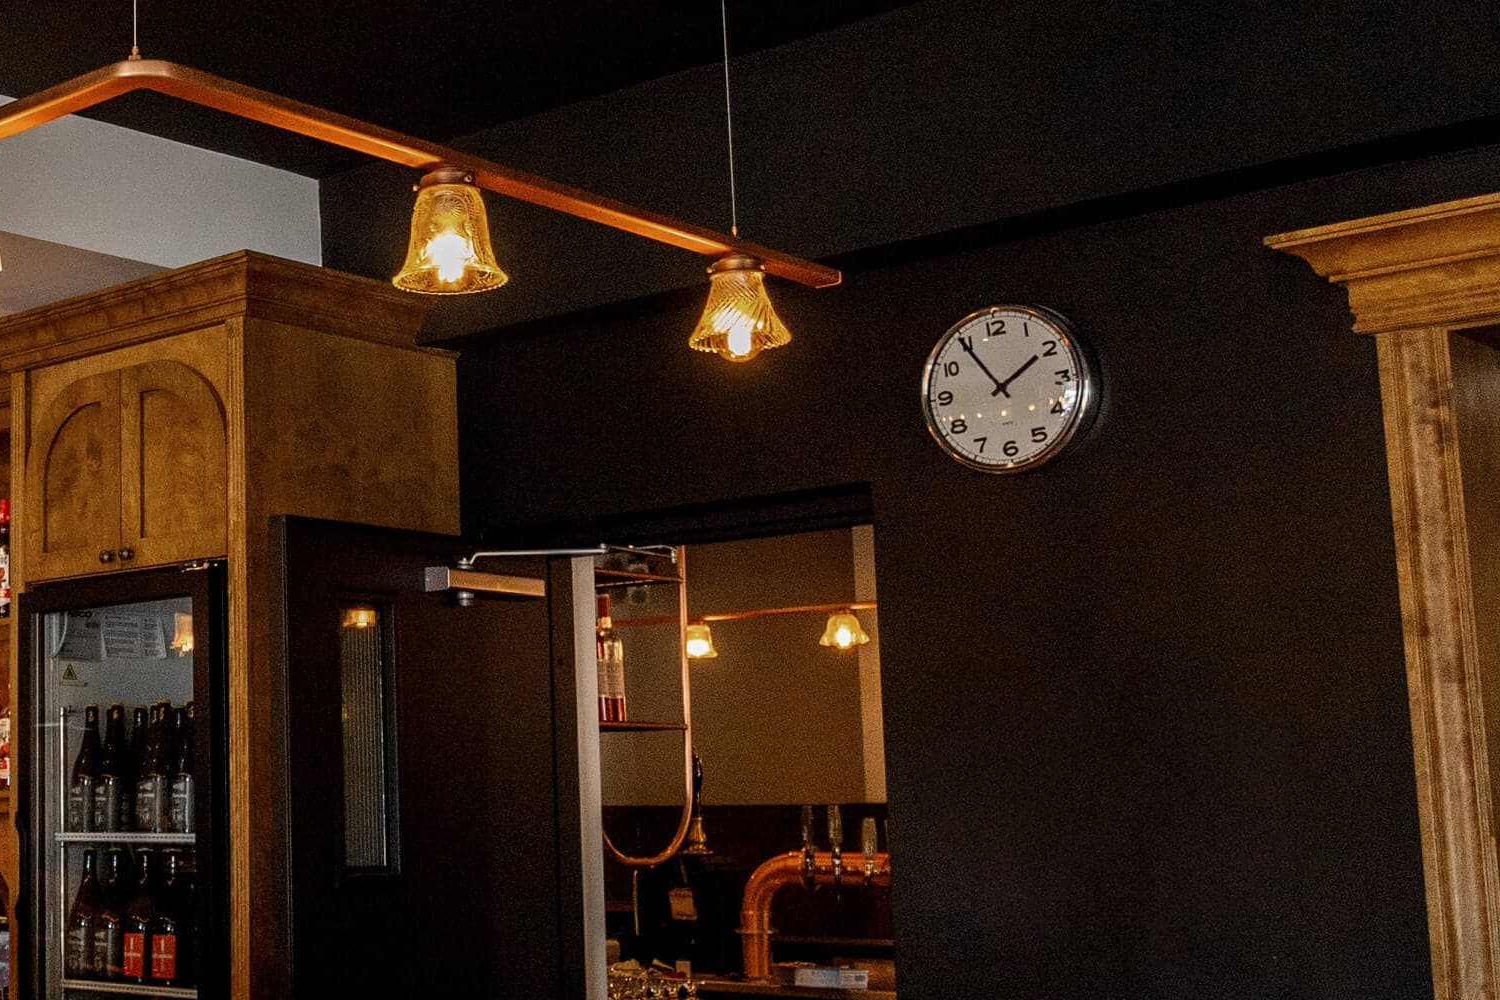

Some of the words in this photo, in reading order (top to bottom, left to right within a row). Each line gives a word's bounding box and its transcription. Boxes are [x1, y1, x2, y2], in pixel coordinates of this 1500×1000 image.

[986, 320, 1006, 337] 12
[1023, 322, 1029, 337] 1
[1041, 340, 1058, 357] 2
[944, 361, 960, 378] 10
[1054, 369, 1071, 386] 3
[938, 391, 953, 406] 9
[1050, 400, 1065, 416] 4
[950, 419, 968, 434] 8
[1031, 426, 1048, 443] 5
[973, 437, 988, 453] 7
[1002, 440, 1019, 457] 6
